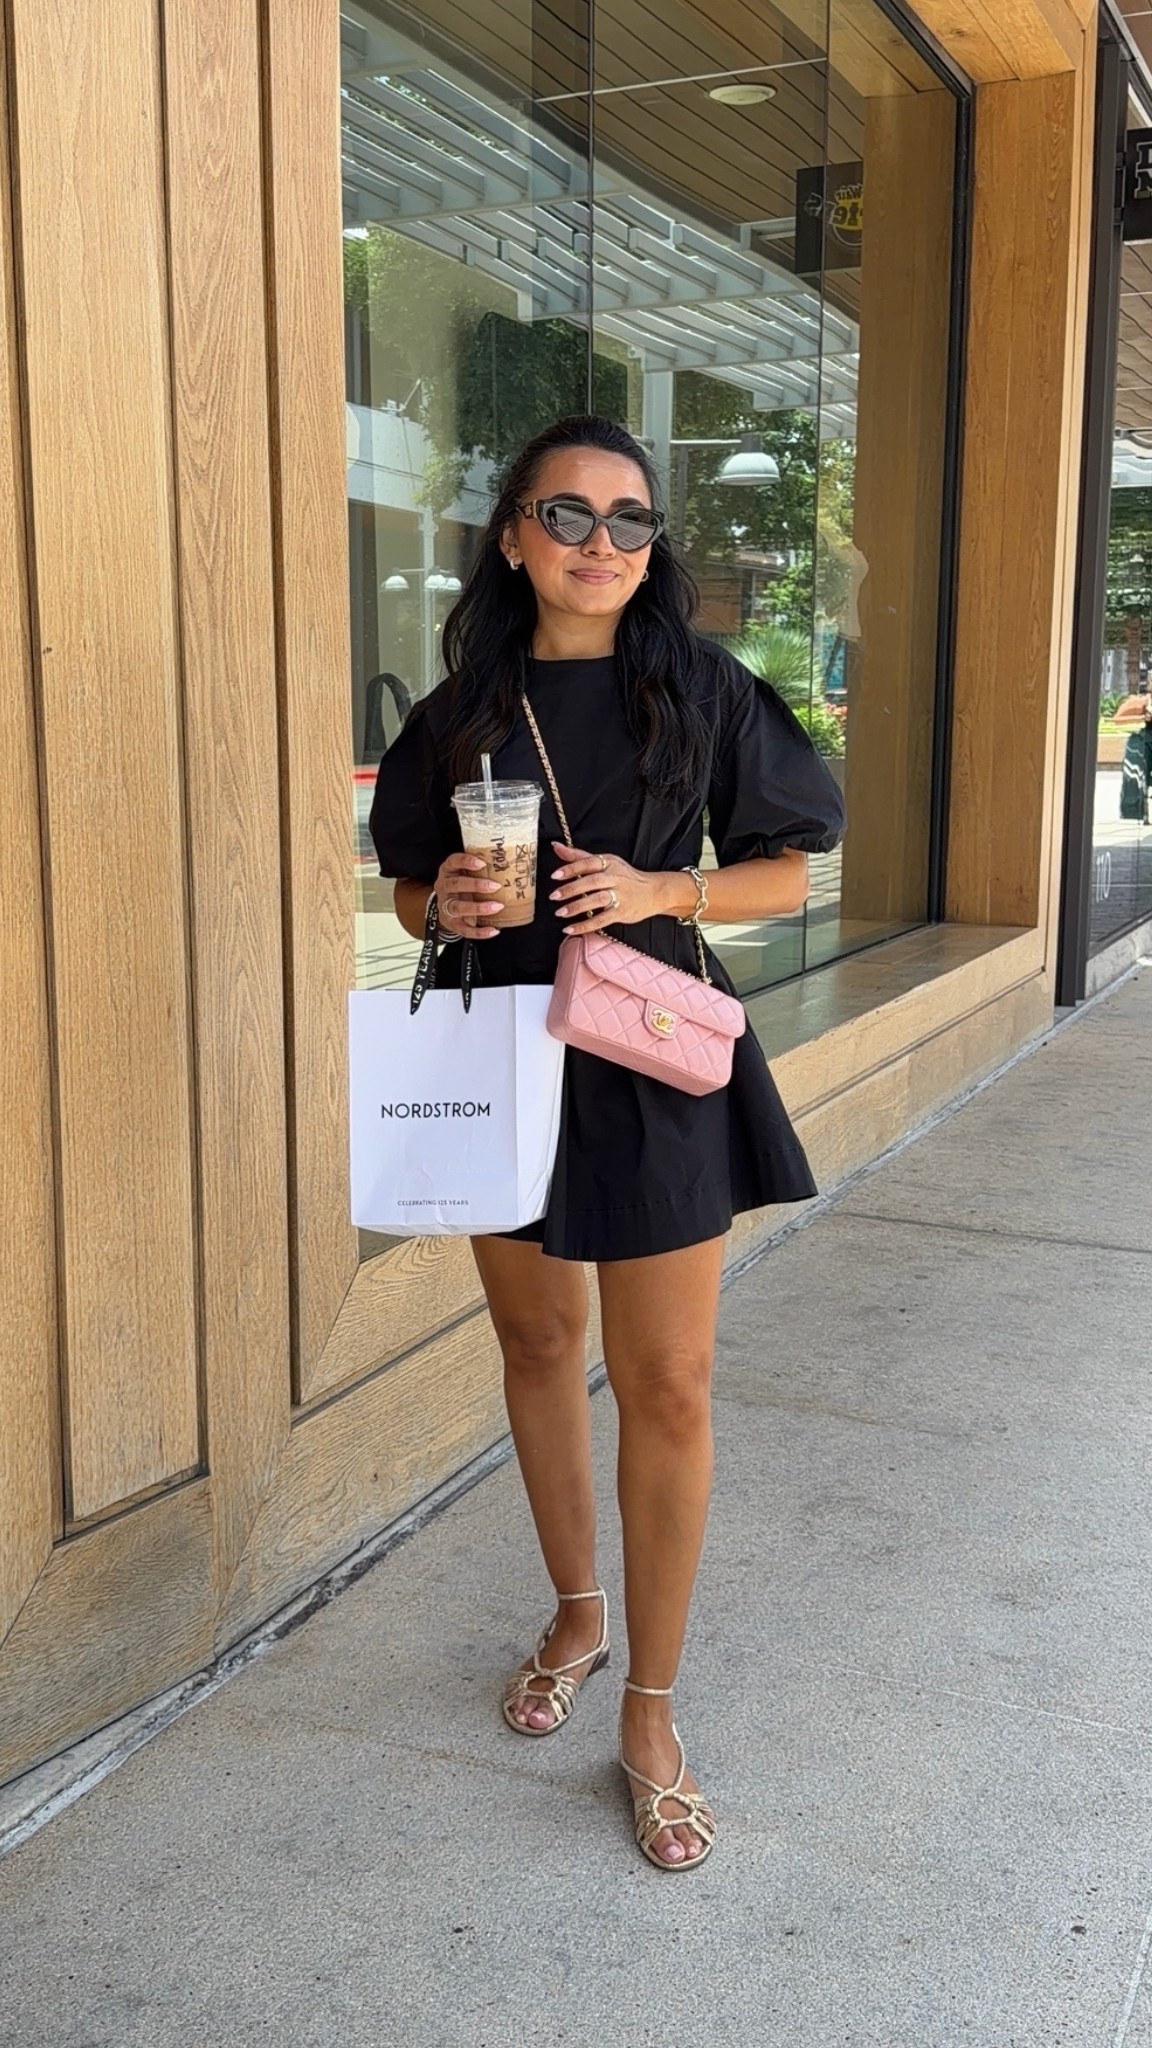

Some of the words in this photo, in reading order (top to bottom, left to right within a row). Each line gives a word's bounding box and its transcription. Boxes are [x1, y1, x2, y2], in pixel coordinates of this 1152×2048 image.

[416, 940, 434, 980] YEARS
[412, 984, 423, 1004] 125
[381, 1101, 491, 1119] NORDSTROM
[397, 1199, 437, 1207] CELEBRATING
